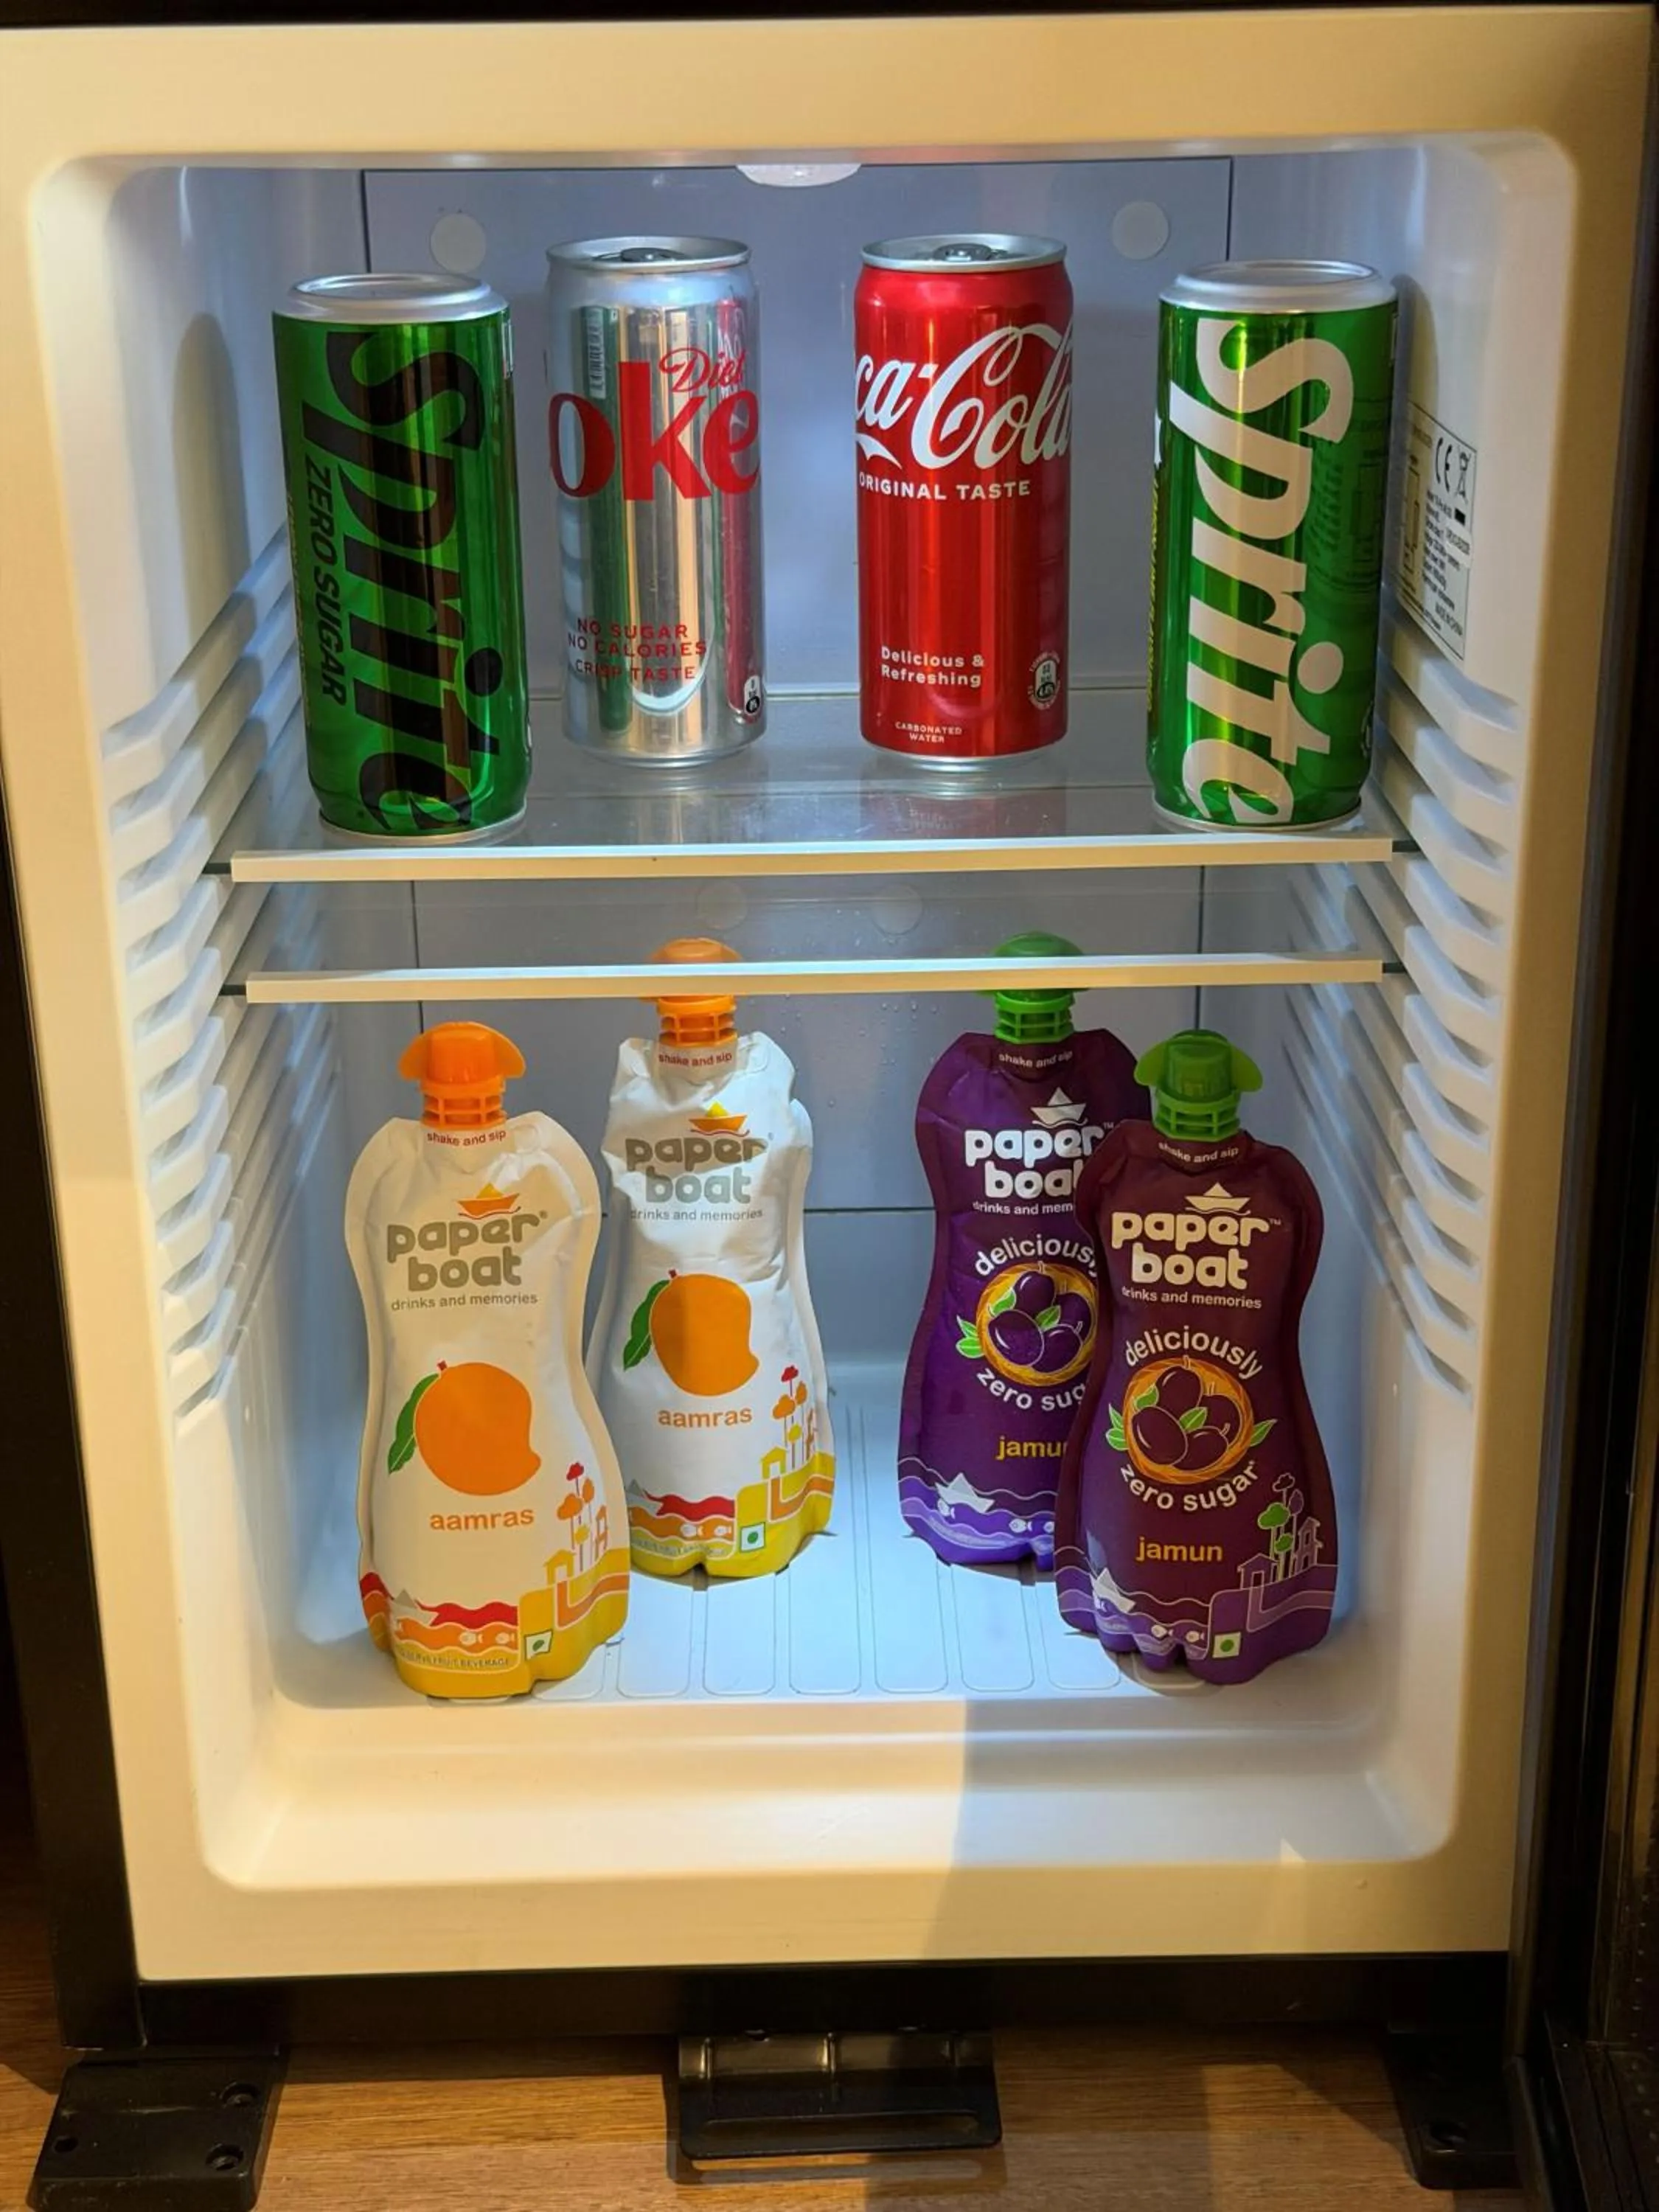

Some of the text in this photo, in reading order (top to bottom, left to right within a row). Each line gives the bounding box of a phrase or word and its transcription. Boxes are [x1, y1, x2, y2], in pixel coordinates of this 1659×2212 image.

[658, 347, 745, 392] Diet
[855, 319, 1072, 469] ca-Cola
[549, 361, 759, 501] oke
[859, 472, 1031, 501] ORIGINAL TASTE
[302, 332, 503, 830] Sprite
[303, 454, 347, 706] ZERO SUGAR
[1169, 318, 1354, 824] Sprite
[577, 617, 688, 640] NO SUGAR
[568, 633, 706, 658] NO CALORIES
[881, 646, 984, 667] Delicious &
[575, 659, 695, 681] CRISP TASTE
[881, 664, 981, 688] Refreshing
[894, 721, 962, 735] CARBONATED
[909, 732, 945, 743] WATER
[658, 1051, 732, 1067] shake and sip
[998, 1051, 1074, 1068] shake and sip
[427, 1130, 507, 1146] shake and sip
[964, 1125, 1105, 1168] paper
[625, 1138, 769, 1172] paper
[1158, 1143, 1239, 1163] shake and sip
[646, 1166, 751, 1203] boat
[630, 1208, 763, 1221] drinks and memories
[973, 1201, 1011, 1214] drinks
[1014, 1203, 1039, 1215] and
[387, 1213, 540, 1263] paper
[1111, 1211, 1270, 1251] paper
[408, 1246, 521, 1291] boat
[975, 1234, 1097, 1278] delicious
[1132, 1242, 1248, 1290] boat
[392, 1293, 538, 1312] drinks and memories
[1121, 1286, 1262, 1310] drinks and memories
[1125, 1325, 1263, 1381] deliciously
[977, 1368, 1085, 1411] zero sug
[658, 1408, 752, 1428] aamras
[1120, 1460, 1259, 1512] zero sugar
[430, 1509, 535, 1531] aamras
[1135, 1537, 1223, 1562] jamun
